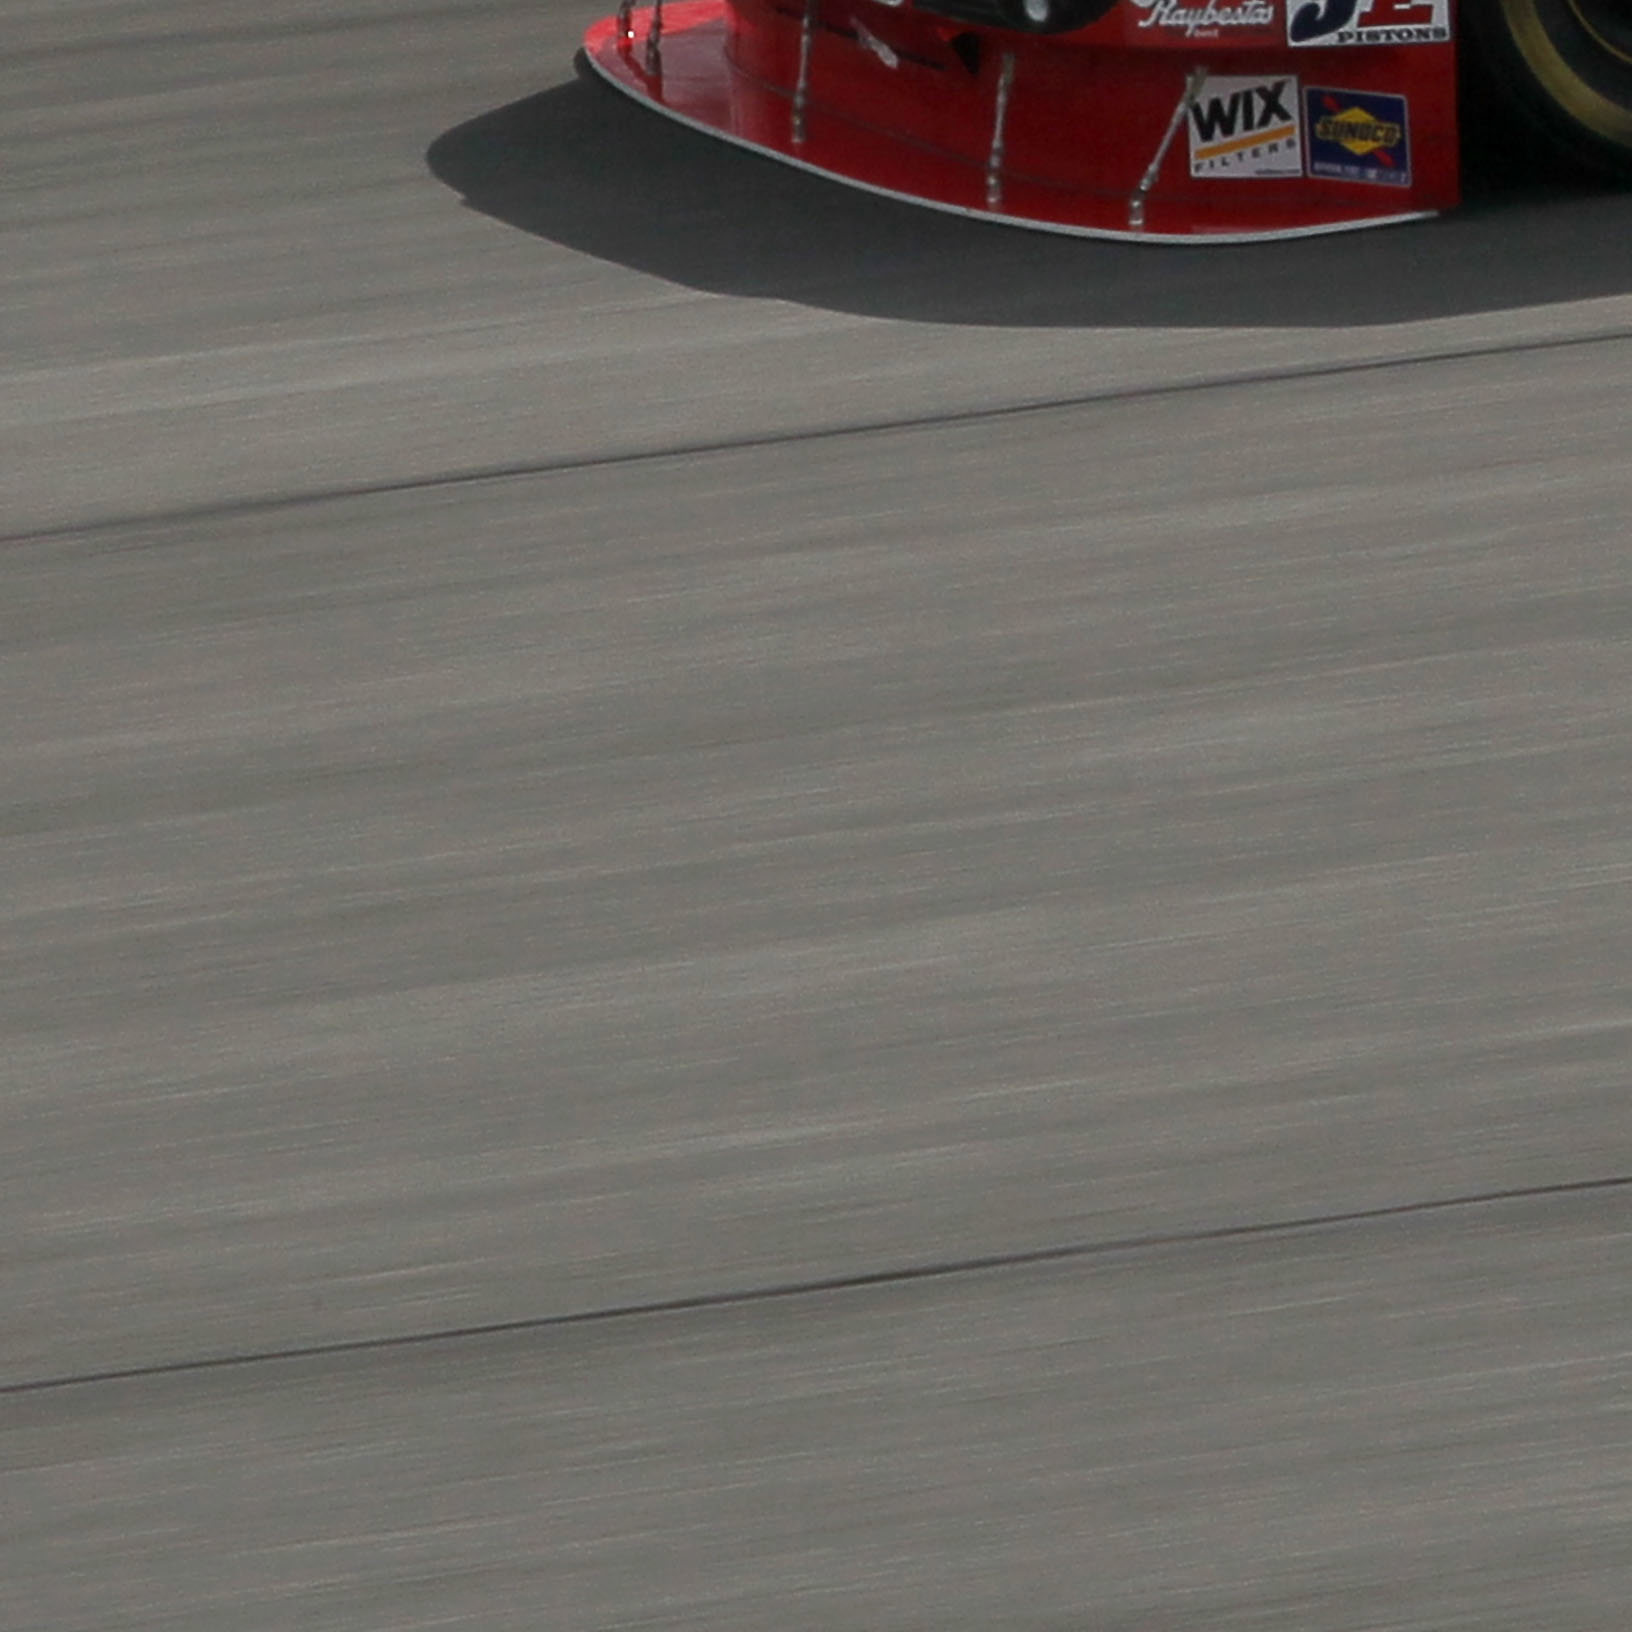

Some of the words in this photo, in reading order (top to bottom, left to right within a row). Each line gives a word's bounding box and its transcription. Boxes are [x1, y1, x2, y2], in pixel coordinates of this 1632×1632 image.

[1336, 26, 1448, 43] PISTONS
[1191, 77, 1293, 143] WIX
[1315, 115, 1402, 147] SUNOCO
[1194, 137, 1298, 173] FILTERS
